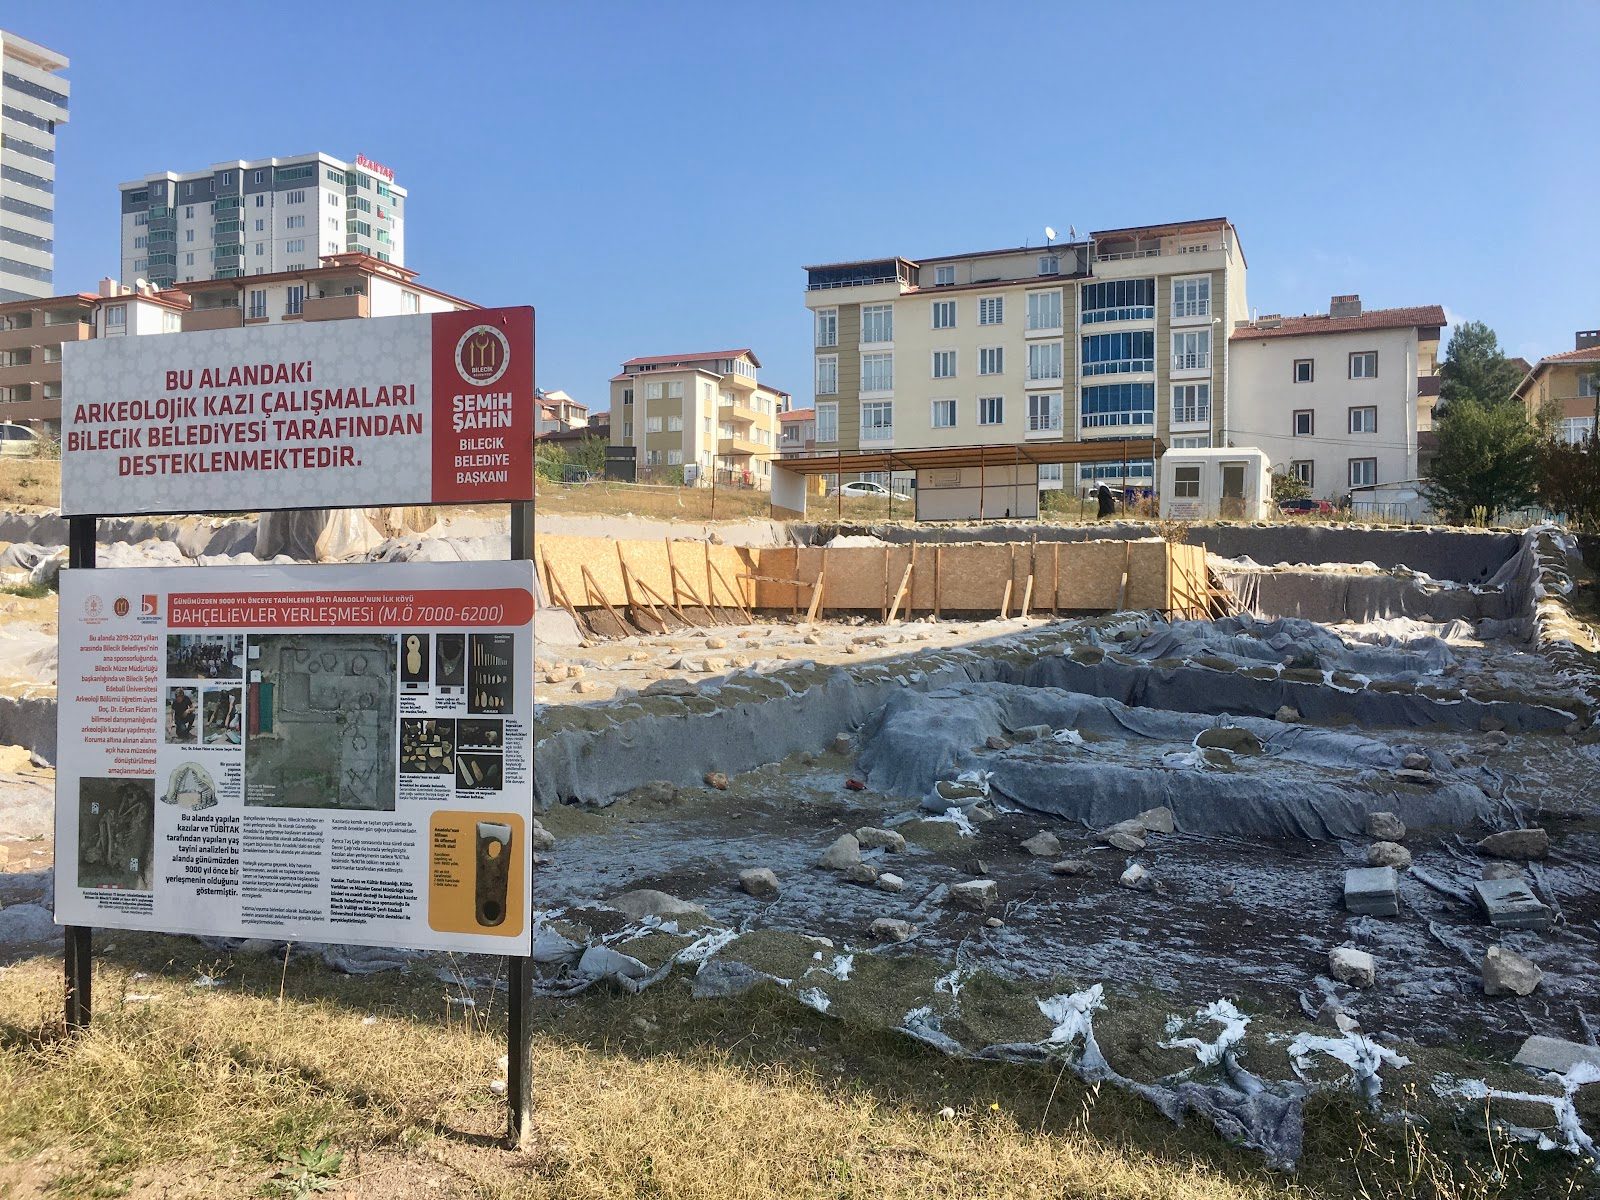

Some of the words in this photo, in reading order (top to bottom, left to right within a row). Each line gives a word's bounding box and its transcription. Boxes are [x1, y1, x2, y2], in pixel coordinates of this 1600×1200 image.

[166, 370, 192, 390] BU
[199, 361, 312, 388] ALANDAKİ
[74, 397, 197, 424] ARKEOLOJİK
[203, 394, 254, 416] KAZI
[261, 384, 414, 418] ÇALIŞMALARI
[453, 393, 512, 412] SEMİH
[453, 411, 512, 433] ŞAHİN
[68, 428, 142, 452] BİLECİK
[148, 421, 266, 447] BELEDİYESİ
[273, 413, 422, 440] TARAFINDAN
[460, 437, 504, 450] BİLECİK
[119, 446, 362, 476] DESTEKLENMEKTEDİR.
[455, 454, 509, 467] BELEDİYE
[457, 471, 507, 486] BAŞKANI
[173, 608, 277, 626] BAHÇELİEVLER
[282, 606, 374, 625] YERLEŞMESİ
[378, 604, 413, 624] (M.Ö
[417, 604, 504, 623] 7000-6200)
[215, 816, 239, 824] yapılan
[210, 823, 239, 833] TÜBİTAK
[195, 856, 238, 864] günümüzden
[166, 876, 205, 884] yerleşmenin
[207, 877, 238, 886] olduğunu
[196, 887, 238, 897] göstermiştir.
